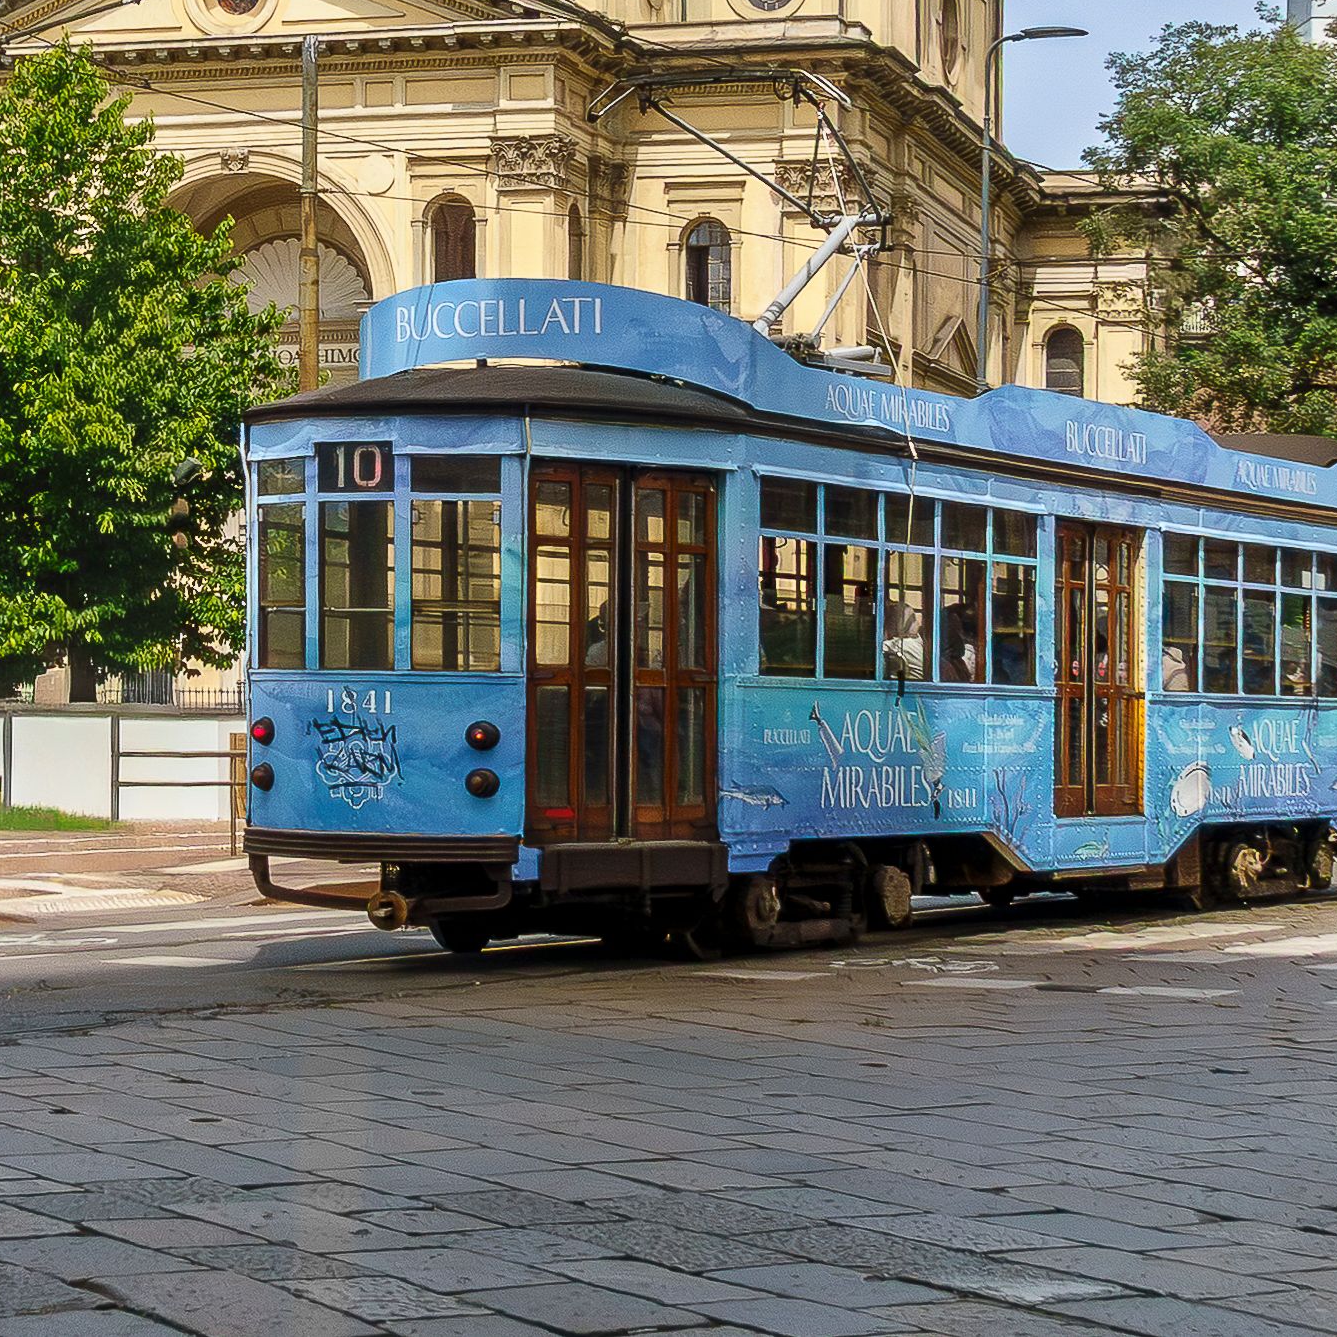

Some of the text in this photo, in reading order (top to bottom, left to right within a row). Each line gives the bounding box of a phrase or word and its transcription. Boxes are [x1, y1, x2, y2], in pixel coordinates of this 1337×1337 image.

[395, 297, 602, 344] BUCCELLATI
[825, 383, 951, 433] AQUAE MIRABILES
[1065, 419, 1147, 465] BUCCELLATI
[334, 444, 382, 488] 10
[326, 688, 392, 714] 1841
[840, 709, 918, 763] AQUAE
[1251, 718, 1300, 762] AQUAE
[820, 765, 933, 809] MIRABILES
[1237, 763, 1312, 798] MIRABILES
